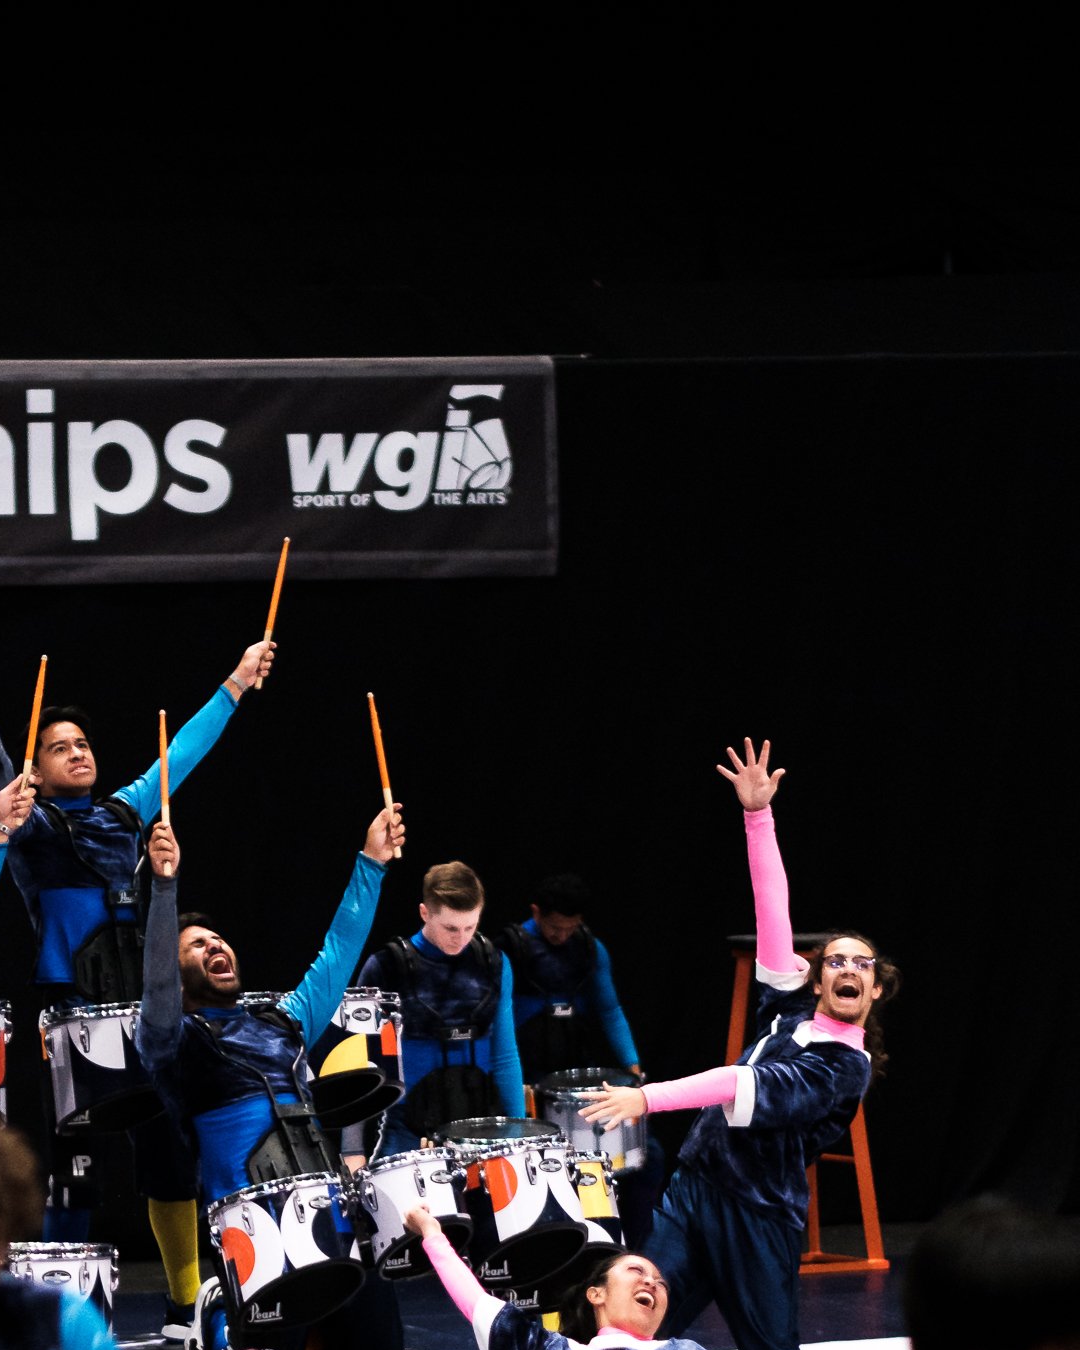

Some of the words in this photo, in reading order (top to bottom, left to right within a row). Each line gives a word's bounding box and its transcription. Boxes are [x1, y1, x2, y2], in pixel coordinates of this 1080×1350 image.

[286, 409, 470, 511] wgi
[292, 494, 346, 508] SPORT
[350, 493, 371, 507] OF
[432, 492, 462, 505] THE
[466, 492, 506, 505] ARTS
[383, 1249, 412, 1269] earl
[476, 1260, 512, 1280] Pearl
[506, 1289, 540, 1308] Pearl
[248, 1302, 283, 1322] Pearl
